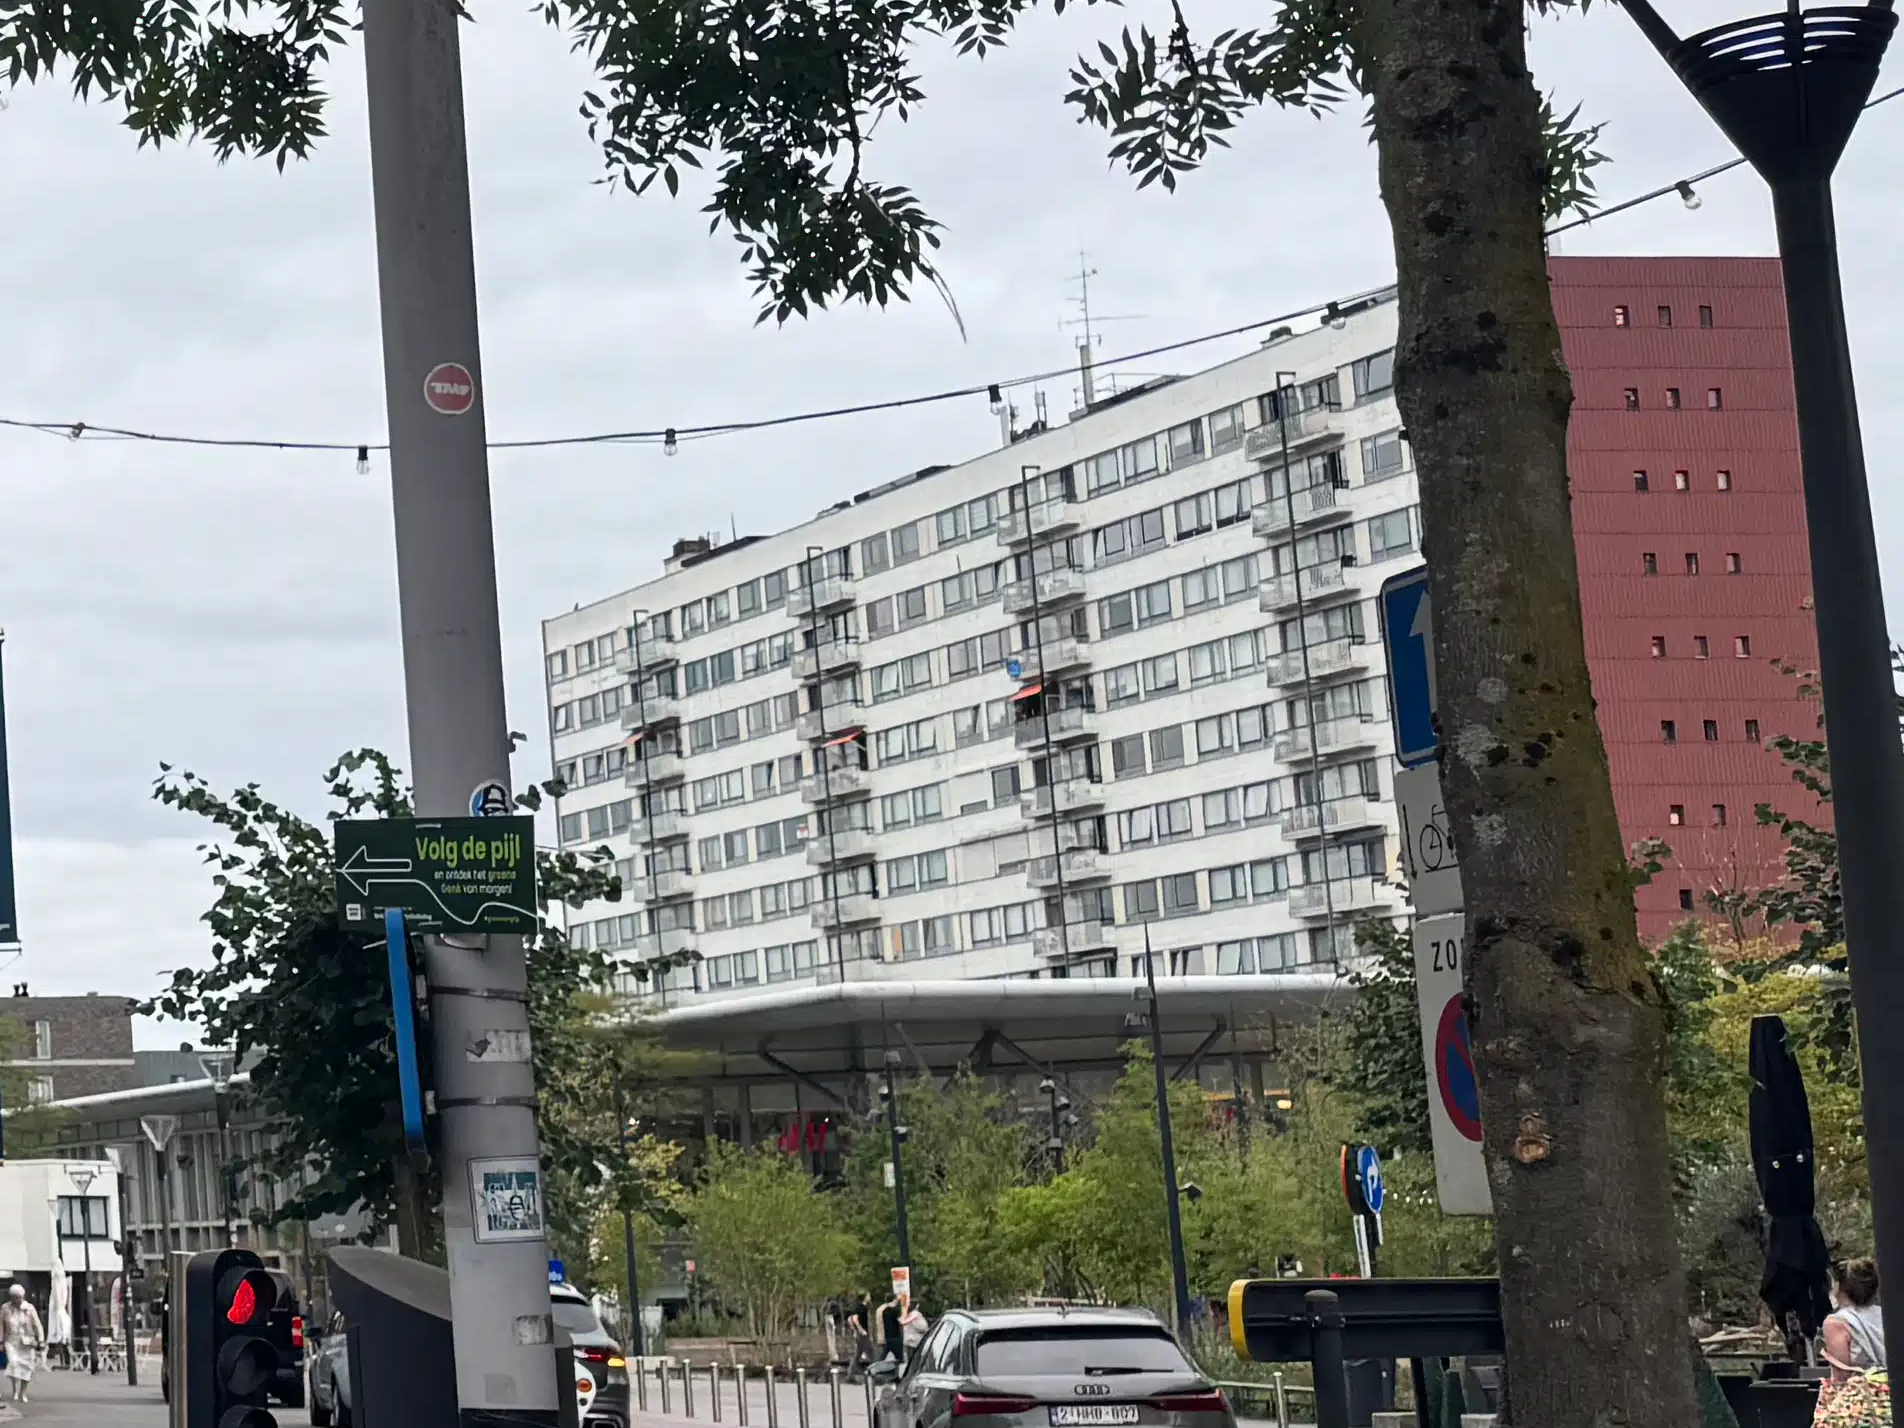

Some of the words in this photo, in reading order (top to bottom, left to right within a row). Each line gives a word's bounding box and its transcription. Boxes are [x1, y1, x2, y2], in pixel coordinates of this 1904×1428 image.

[415, 835, 458, 869] Volg
[462, 835, 487, 861] de
[491, 832, 521, 869] pijl
[1430, 938, 1464, 973] ZO
